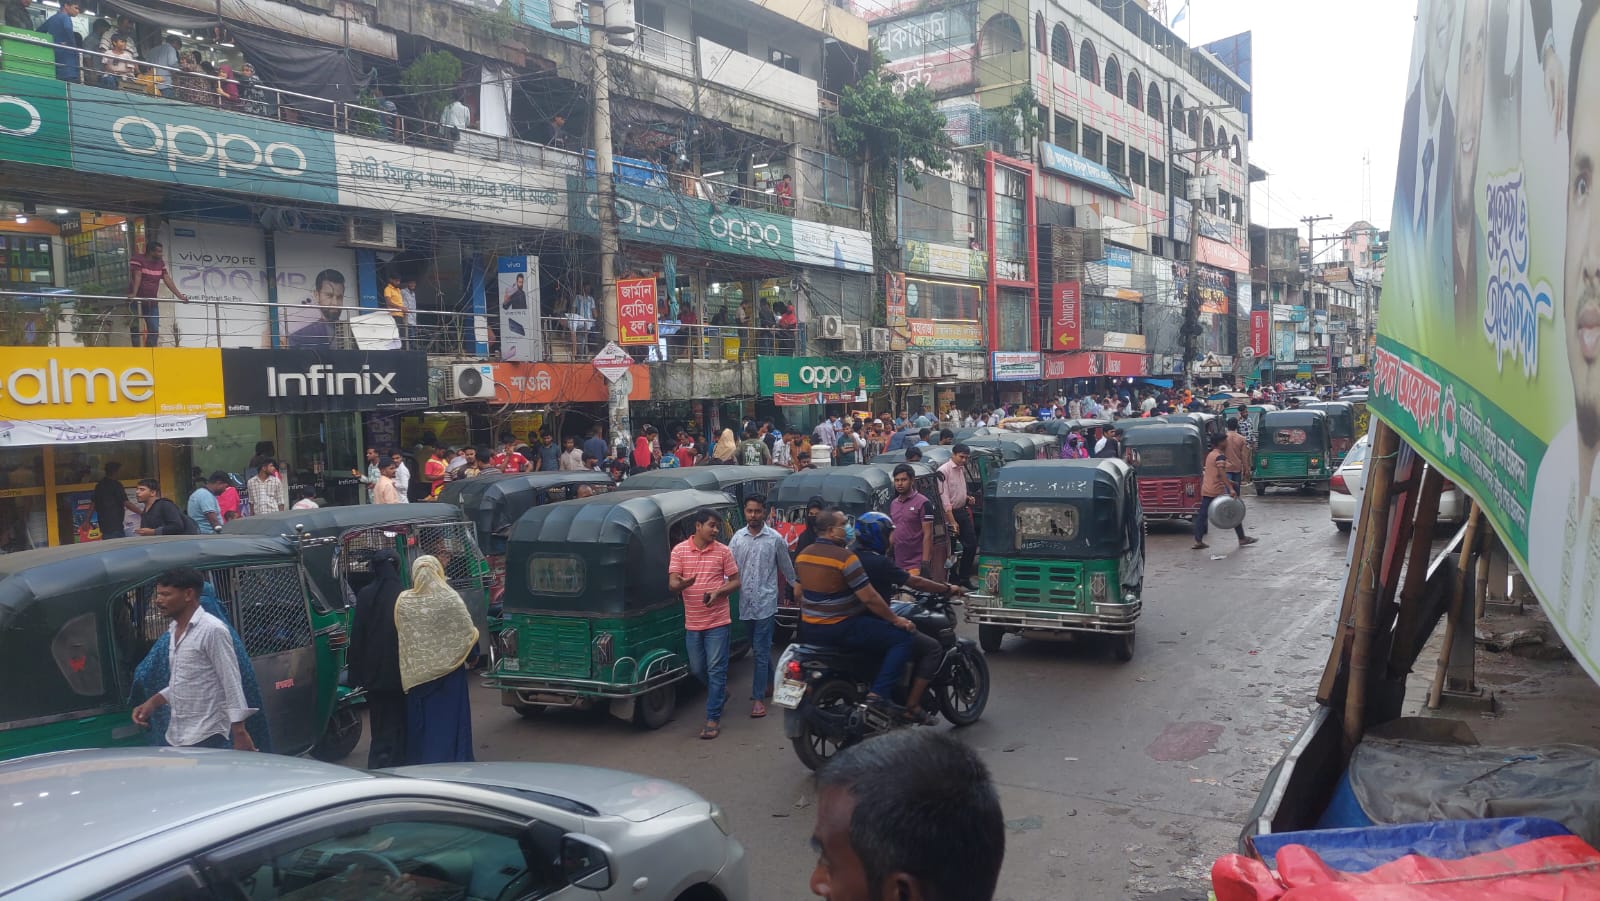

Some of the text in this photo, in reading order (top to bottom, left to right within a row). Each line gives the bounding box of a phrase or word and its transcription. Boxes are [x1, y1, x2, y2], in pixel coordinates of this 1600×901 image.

[112, 115, 306, 176] oppo
[349, 156, 379, 178] হাজী
[426, 168, 456, 193] আলী
[709, 214, 781, 249] oppo
[1485, 171, 1528, 275] শুভেচ্ছা
[179, 251, 257, 265] vivo V70 FE
[179, 265, 254, 290] 200
[620, 281, 652, 299] জার্মান
[621, 299, 654, 318] হোমিও
[1484, 249, 1552, 367] অভিনন্দন
[629, 320, 646, 335] হল
[0, 358, 155, 405] alme
[267, 364, 397, 397] Infinix
[510, 370, 551, 393] শাওমি
[799, 365, 852, 389] oppo
[1397, 359, 1441, 435] আহমেদ
